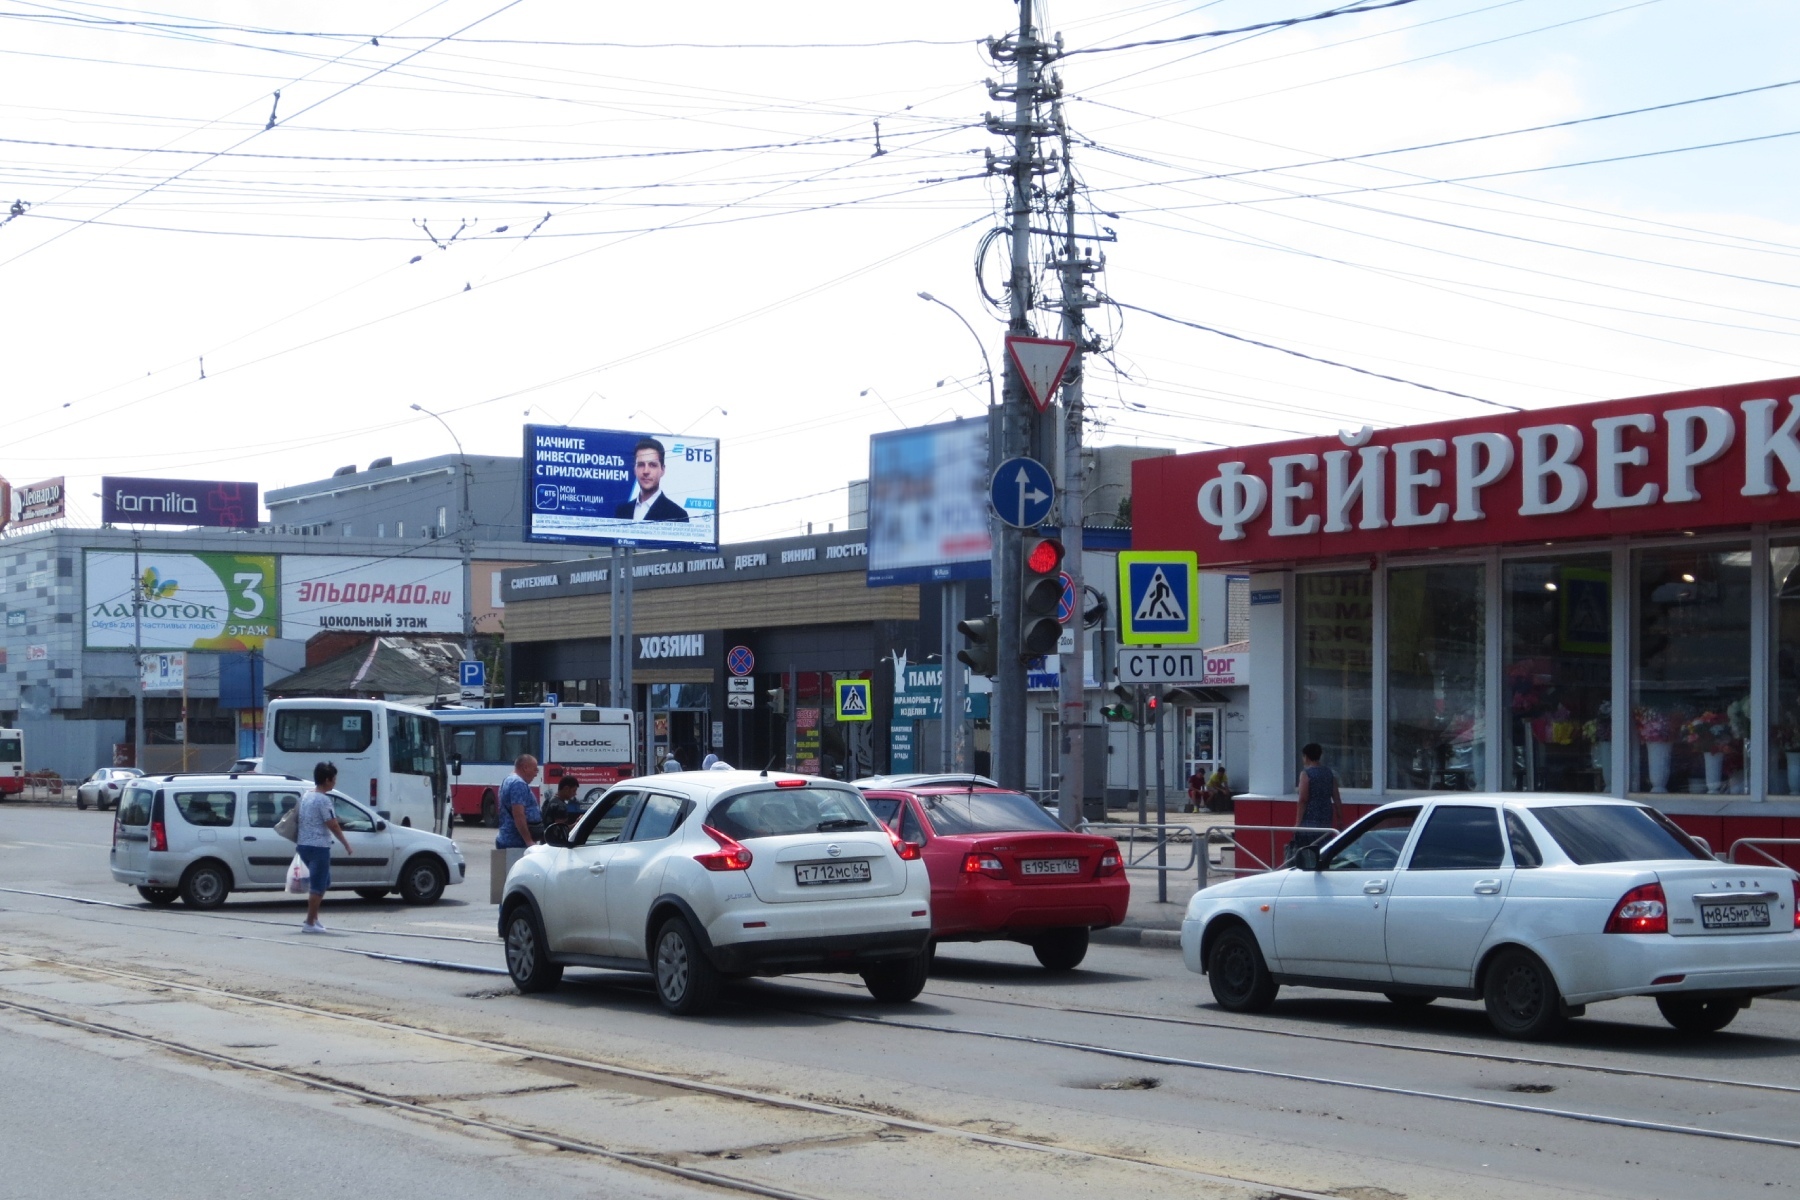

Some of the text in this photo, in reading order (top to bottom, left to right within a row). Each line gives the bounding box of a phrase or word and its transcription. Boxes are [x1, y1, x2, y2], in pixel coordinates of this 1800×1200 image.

[536, 435, 585, 450] НАЧНИТЕ
[536, 450, 625, 467] ИНВЕСТИРОВАТЬ
[686, 448, 713, 462] ВТБ
[536, 464, 629, 481] С ПРИЛОЖЕНИЕМ
[1197, 393, 1800, 542] ФЕЙЕРВЕРК
[22, 485, 59, 507] Леонардо
[560, 485, 576, 493] МОИ
[116, 490, 197, 513] familia
[560, 494, 604, 504] ИНВЕСТИЦИИ
[690, 500, 712, 508] VTB.RU
[734, 553, 768, 571] ДВЕРИ
[781, 548, 817, 564] ВИНИЛ
[619, 557, 725, 579] ЕАМИЧЕСКАЯ ПЛИТКА
[511, 575, 559, 590] САНТЕХНИКА
[569, 569, 609, 585] ЛАМИНАТ
[233, 573, 264, 619] 3
[296, 582, 452, 605] ЭЛЬДОРАДО.RU
[92, 620, 118, 630] Обувь
[188, 622, 219, 631] людей!
[320, 614, 428, 628] цокольный этаж
[228, 625, 268, 635] ЭТАЖ
[639, 633, 705, 659] ХОЗЯИН
[1129, 655, 1194, 677] СТОП
[1203, 655, 1236, 676] орг
[894, 696, 931, 705] МРАМОРНЫЕ
[900, 707, 927, 717] ИЗДЕЛИЯ
[347, 719, 358, 728] 25
[1711, 880, 1760, 889] LADA
